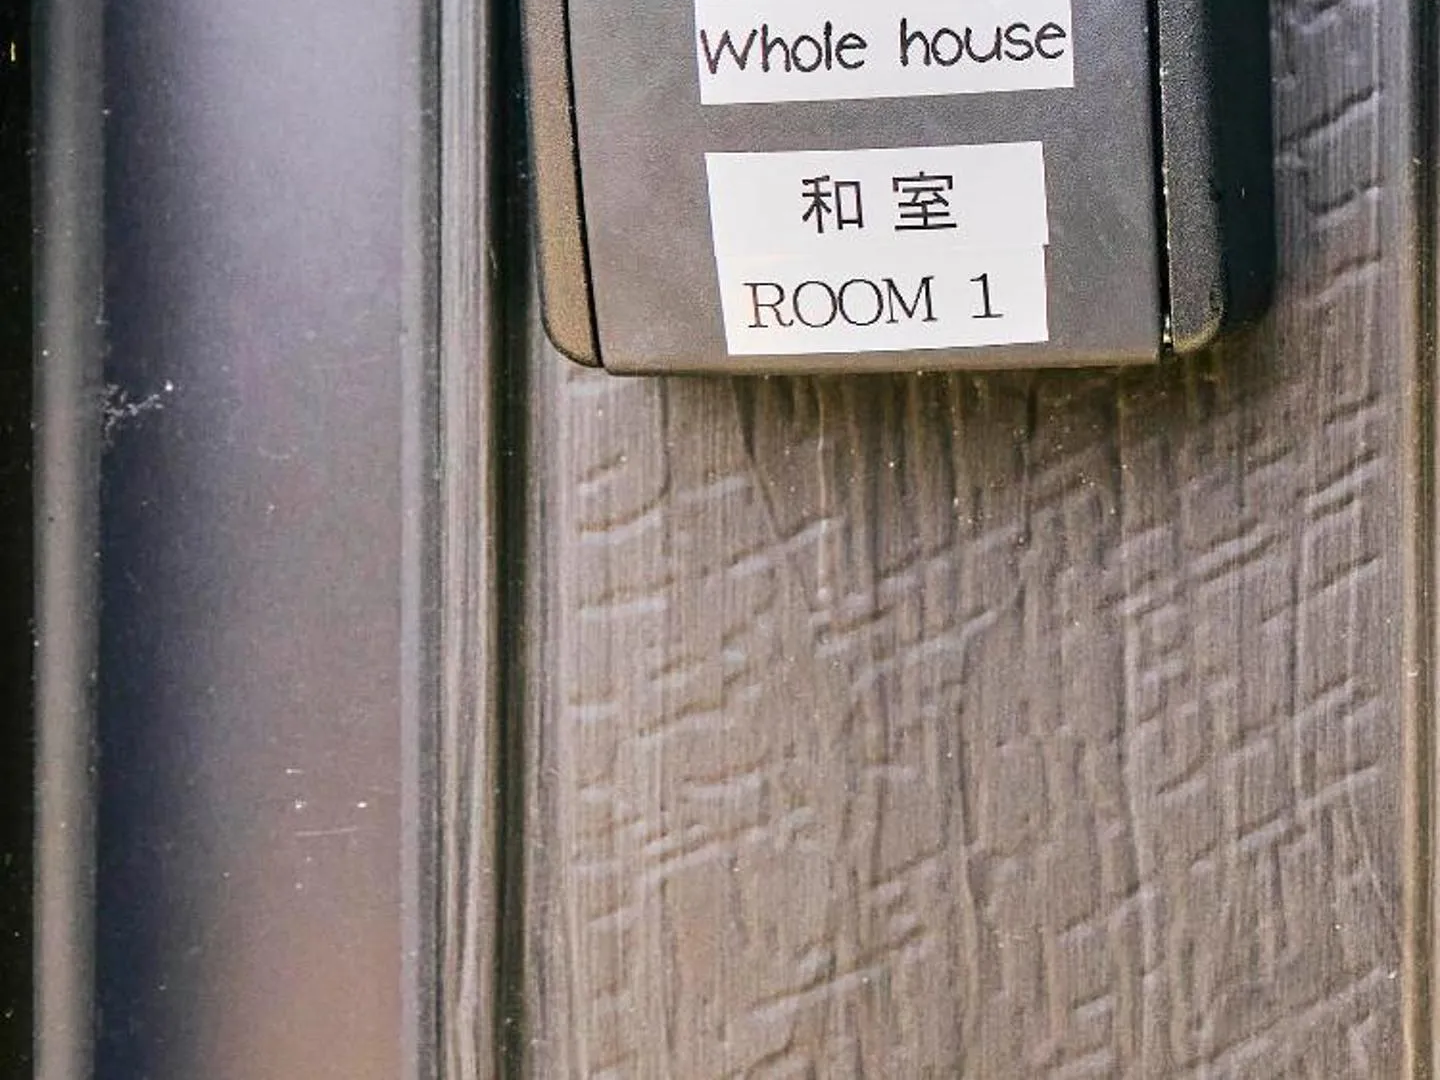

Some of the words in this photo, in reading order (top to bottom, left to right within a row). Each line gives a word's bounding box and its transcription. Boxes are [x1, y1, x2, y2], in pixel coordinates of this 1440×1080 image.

[699, 20, 868, 74] Whole
[899, 17, 1067, 68] house
[801, 170, 958, 234] 和室
[742, 275, 938, 329] ROOM
[969, 272, 1004, 319] 1
